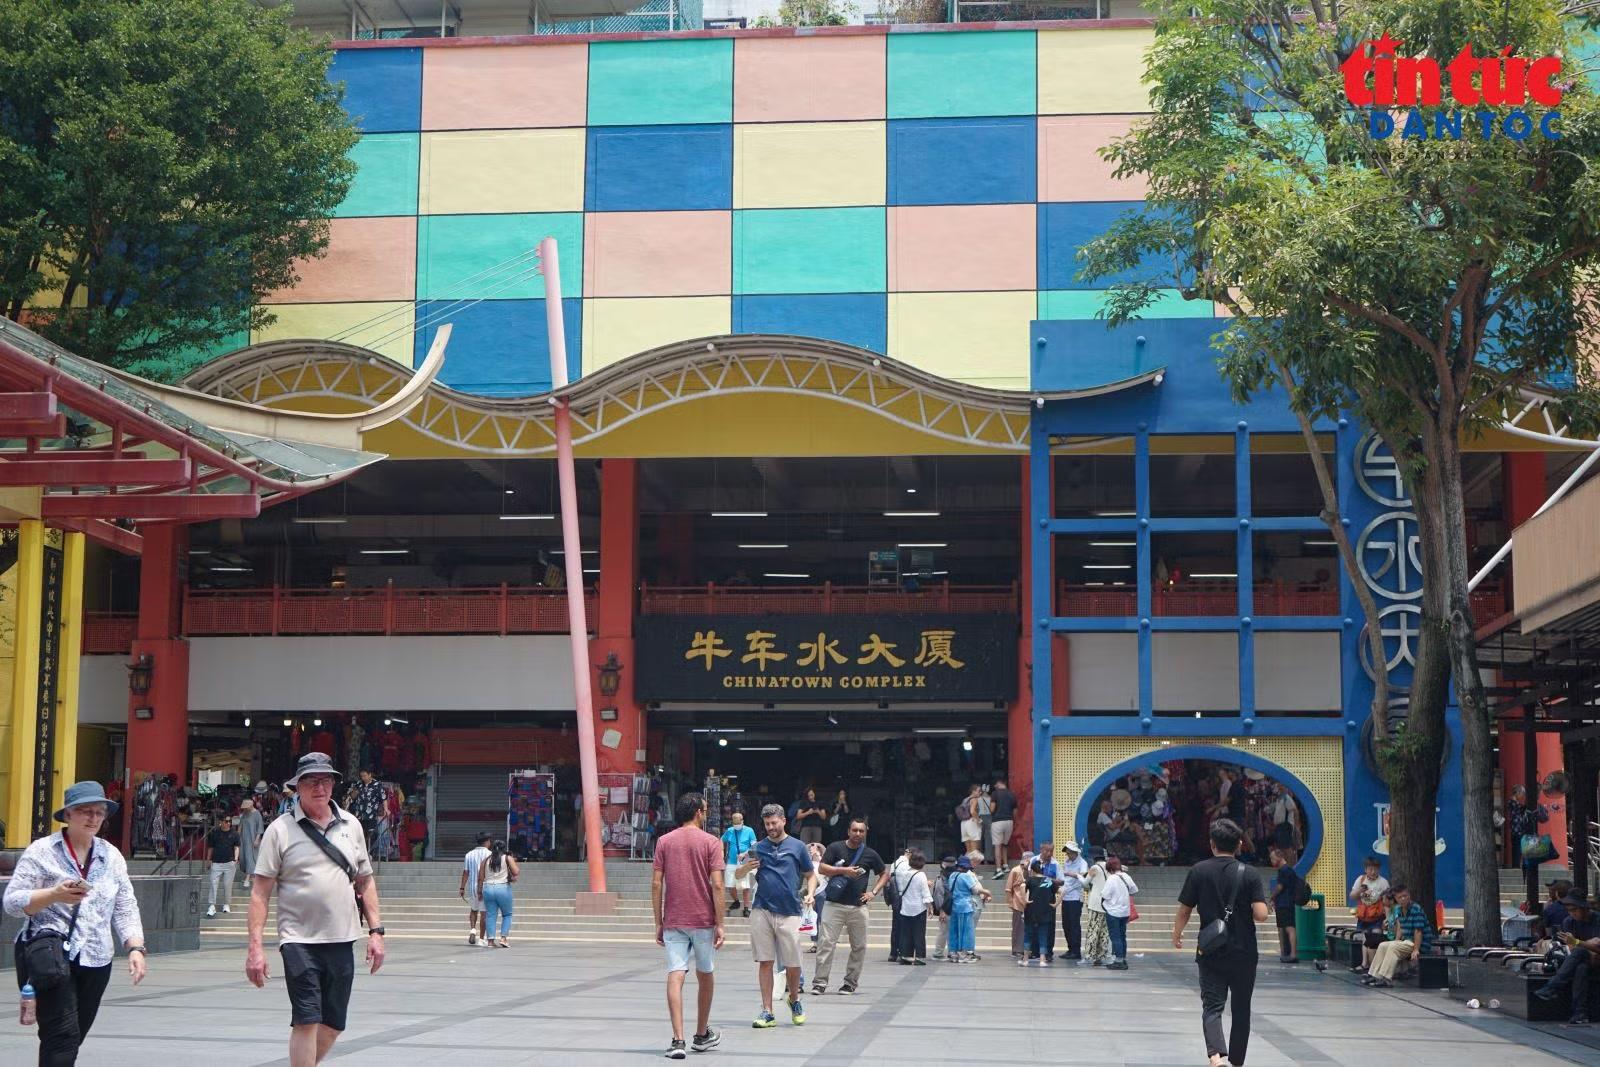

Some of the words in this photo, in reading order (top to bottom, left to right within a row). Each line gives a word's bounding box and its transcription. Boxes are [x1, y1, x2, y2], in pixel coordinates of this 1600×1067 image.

[684, 629, 966, 671] 牛车水大厦
[722, 675, 834, 689] CHINATOWN
[839, 675, 928, 689] COMPLEX
